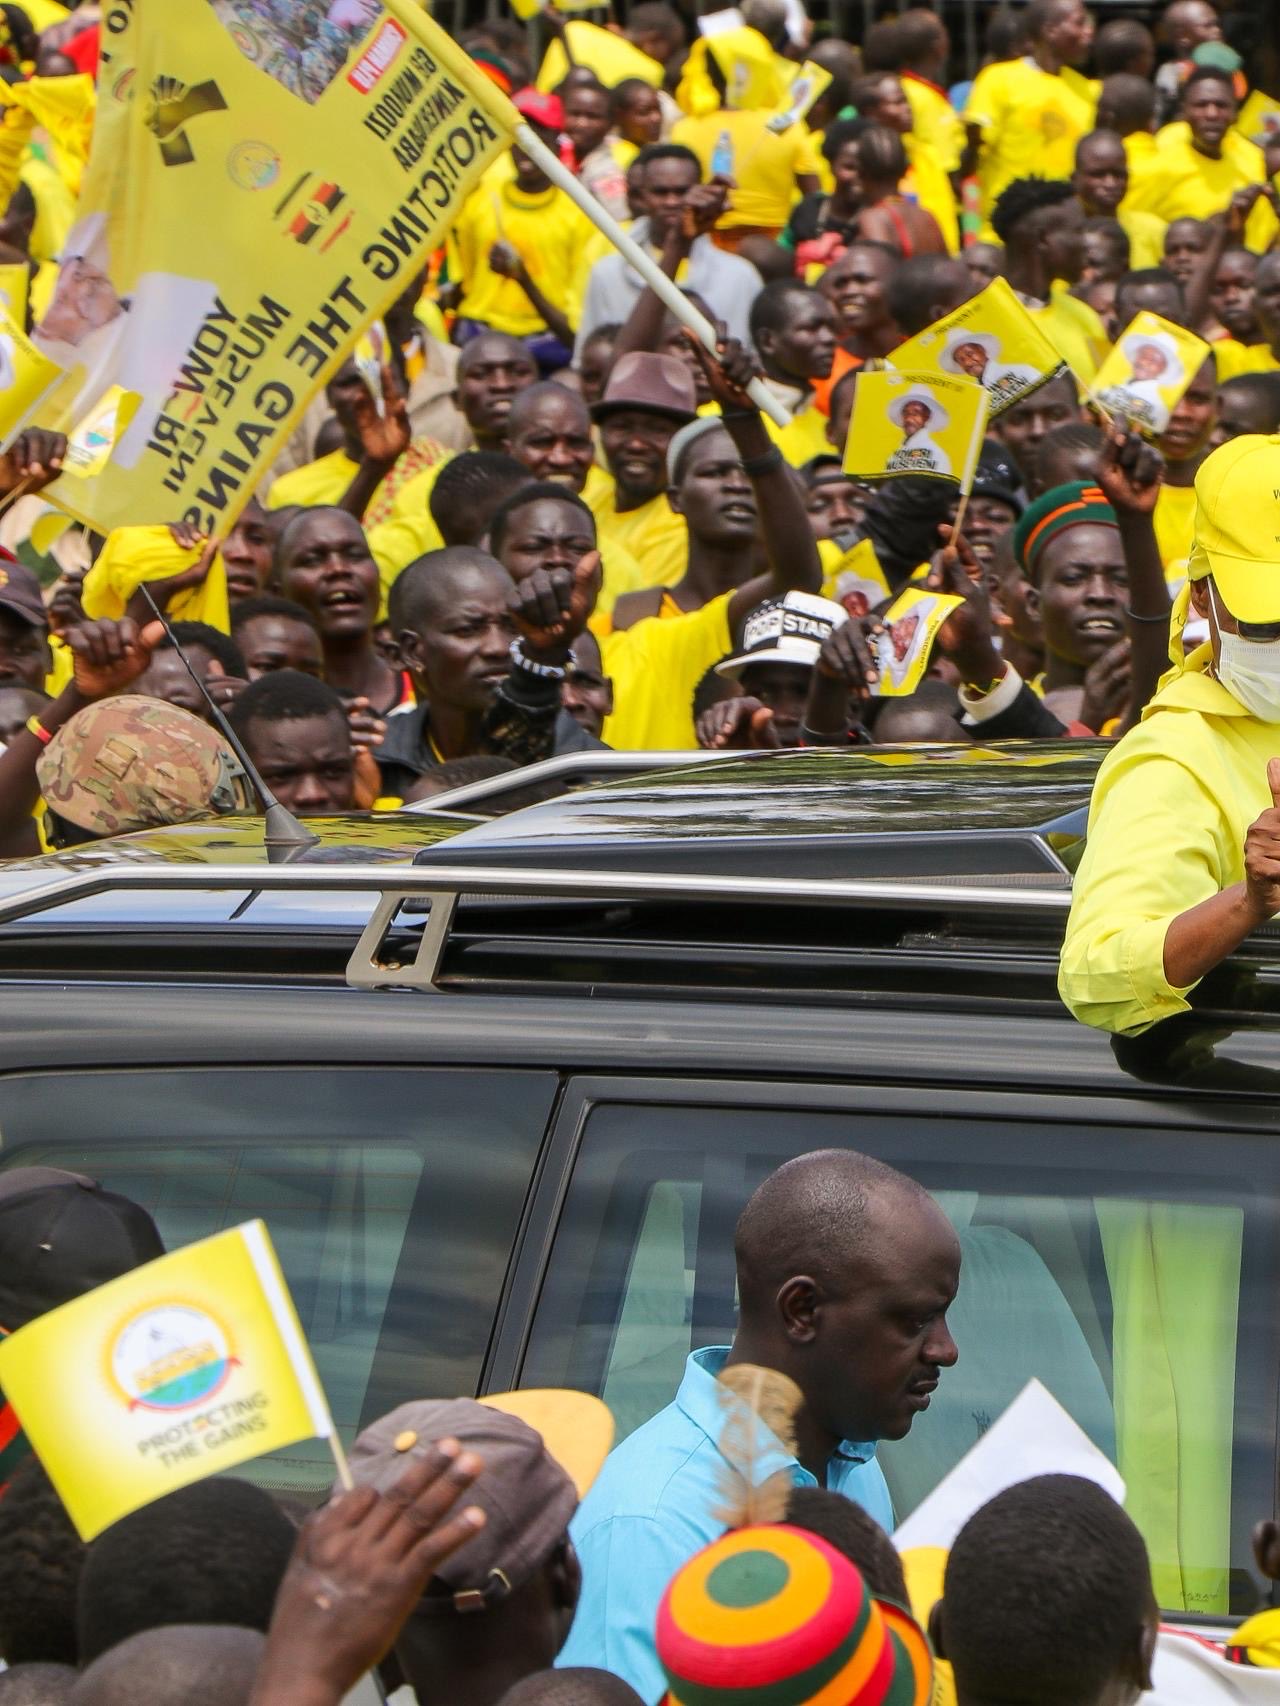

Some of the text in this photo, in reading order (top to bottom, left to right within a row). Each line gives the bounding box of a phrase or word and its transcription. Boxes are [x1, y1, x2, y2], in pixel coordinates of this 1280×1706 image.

[783, 612, 833, 640] STAR
[919, 620, 940, 670] PRESIDENT
[137, 1390, 269, 1456] PROTECTING
[158, 1414, 267, 1468] THE GAINS
